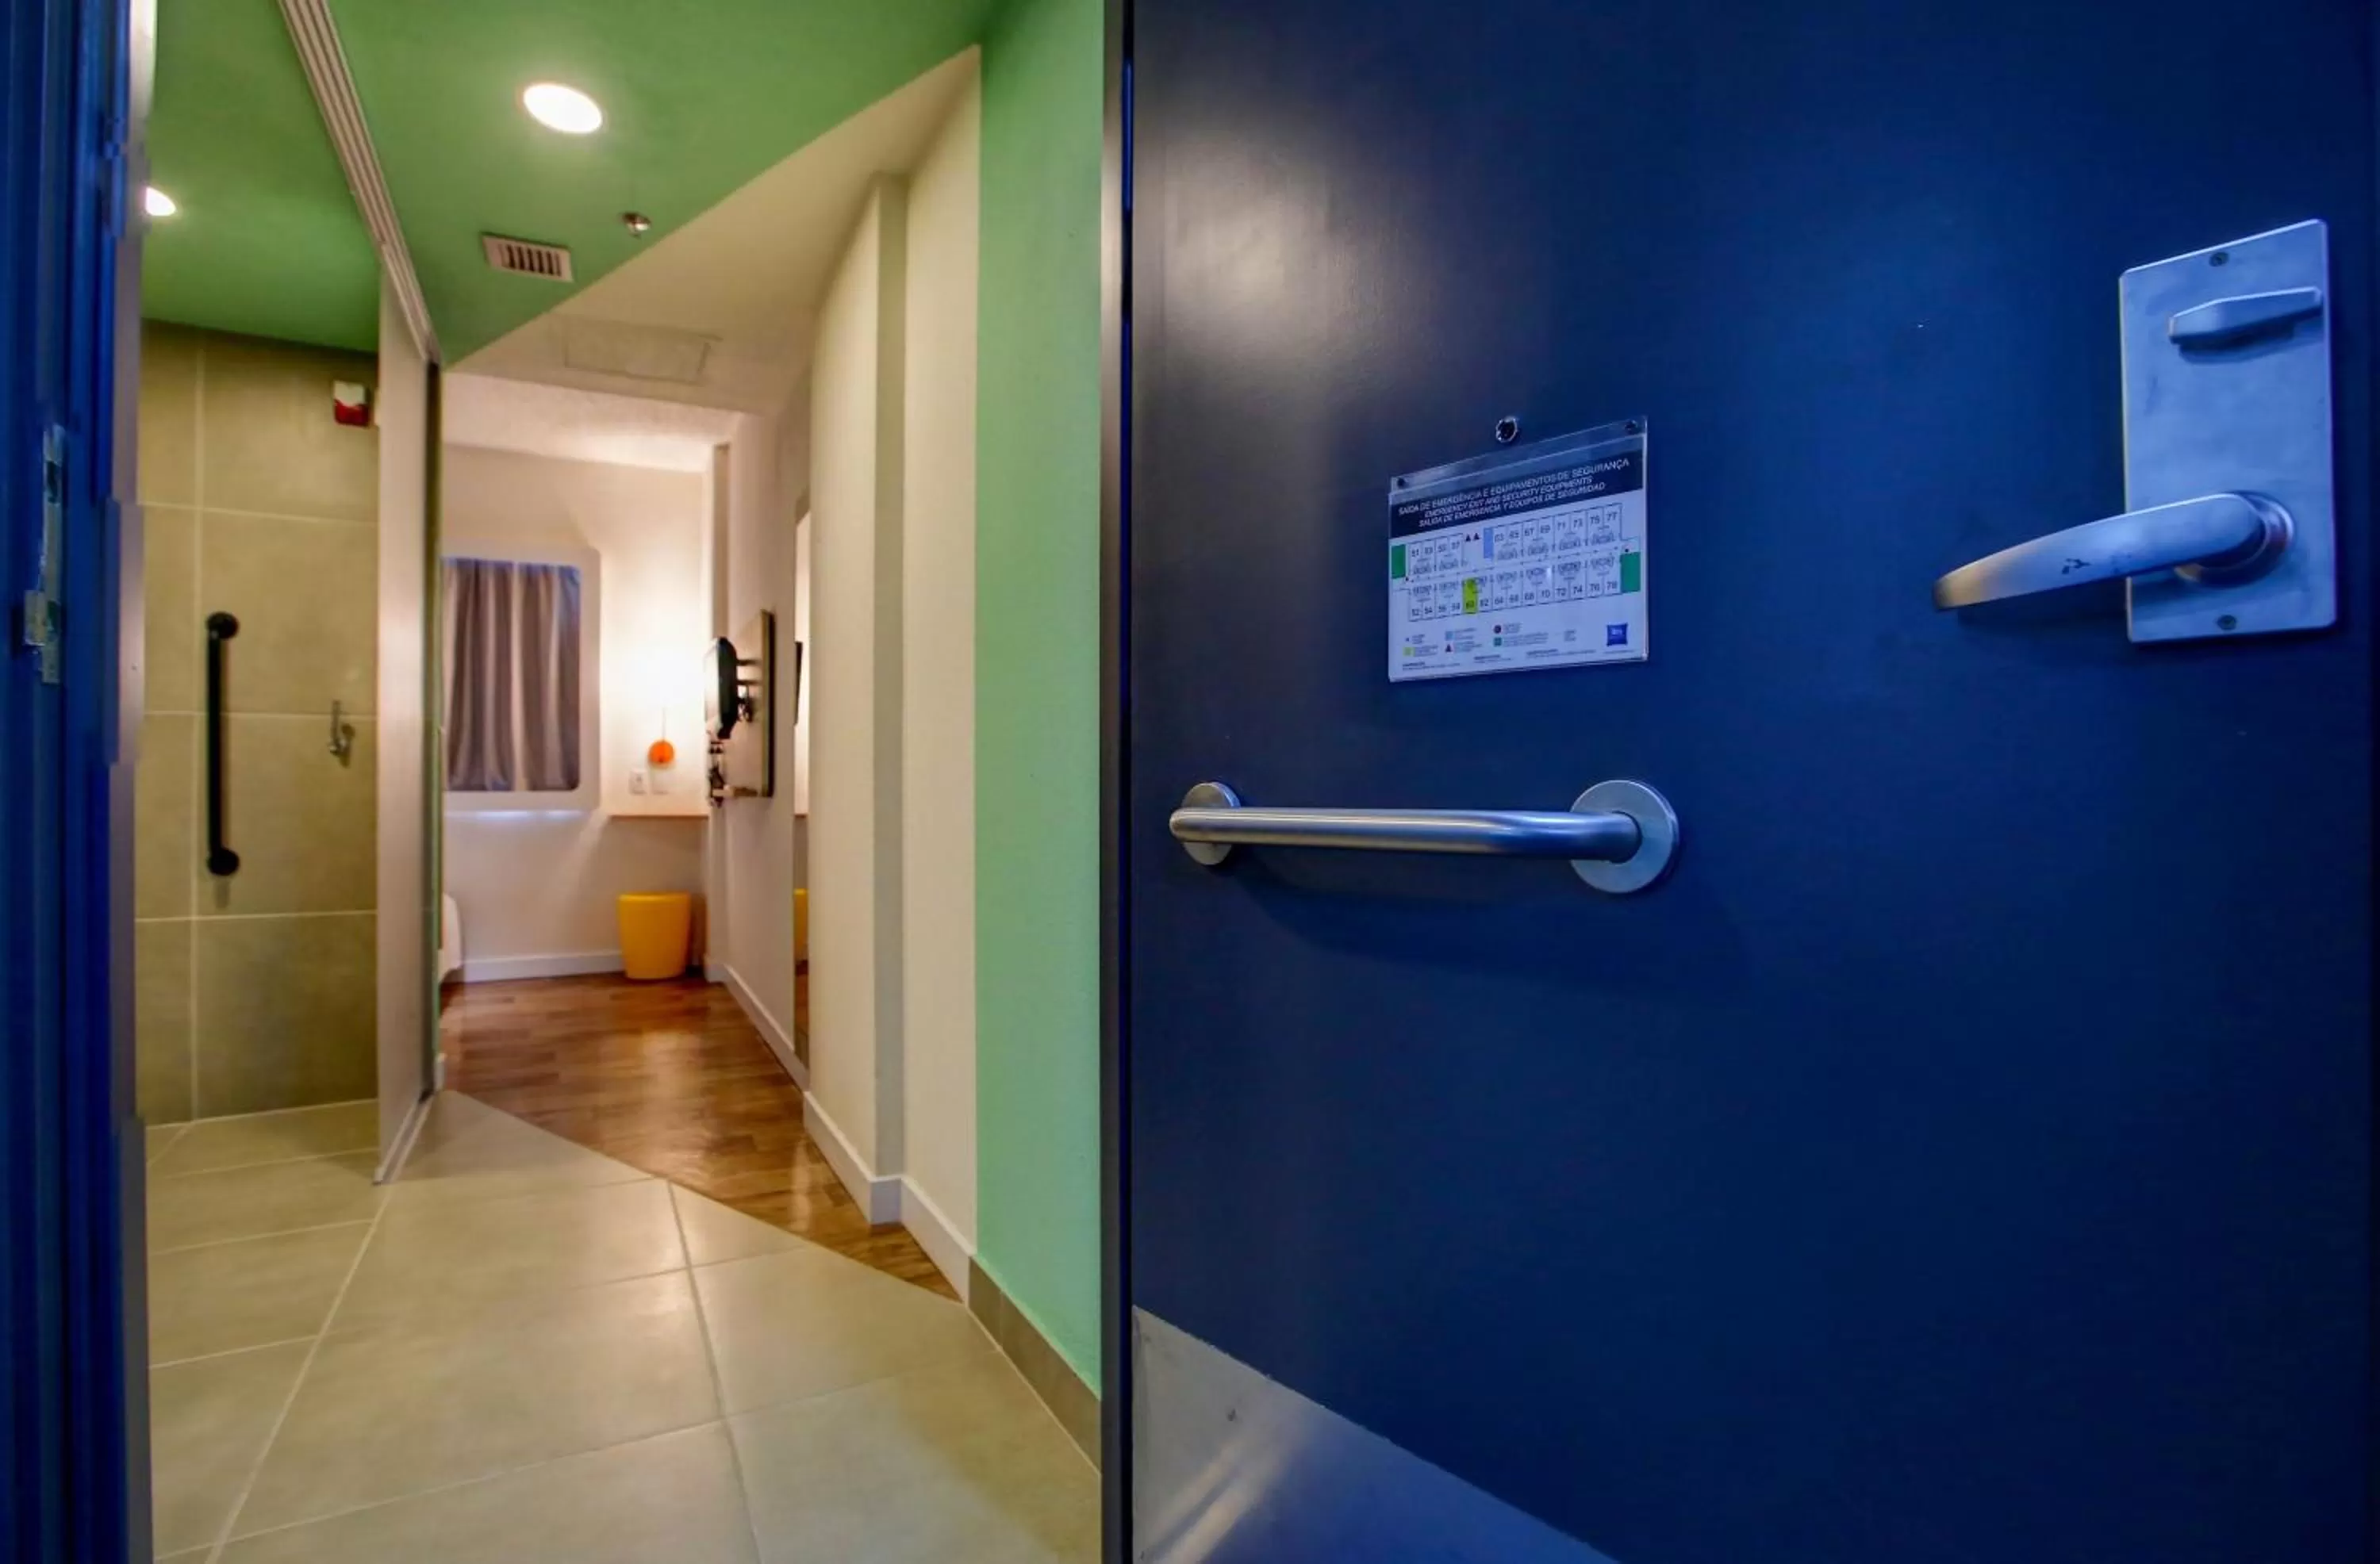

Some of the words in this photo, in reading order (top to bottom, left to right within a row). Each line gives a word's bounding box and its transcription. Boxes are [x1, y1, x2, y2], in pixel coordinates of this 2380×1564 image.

[1572, 458, 1630, 477] SEGURANÇA
[1557, 521, 1566, 531] 71
[1606, 512, 1617, 520] 77
